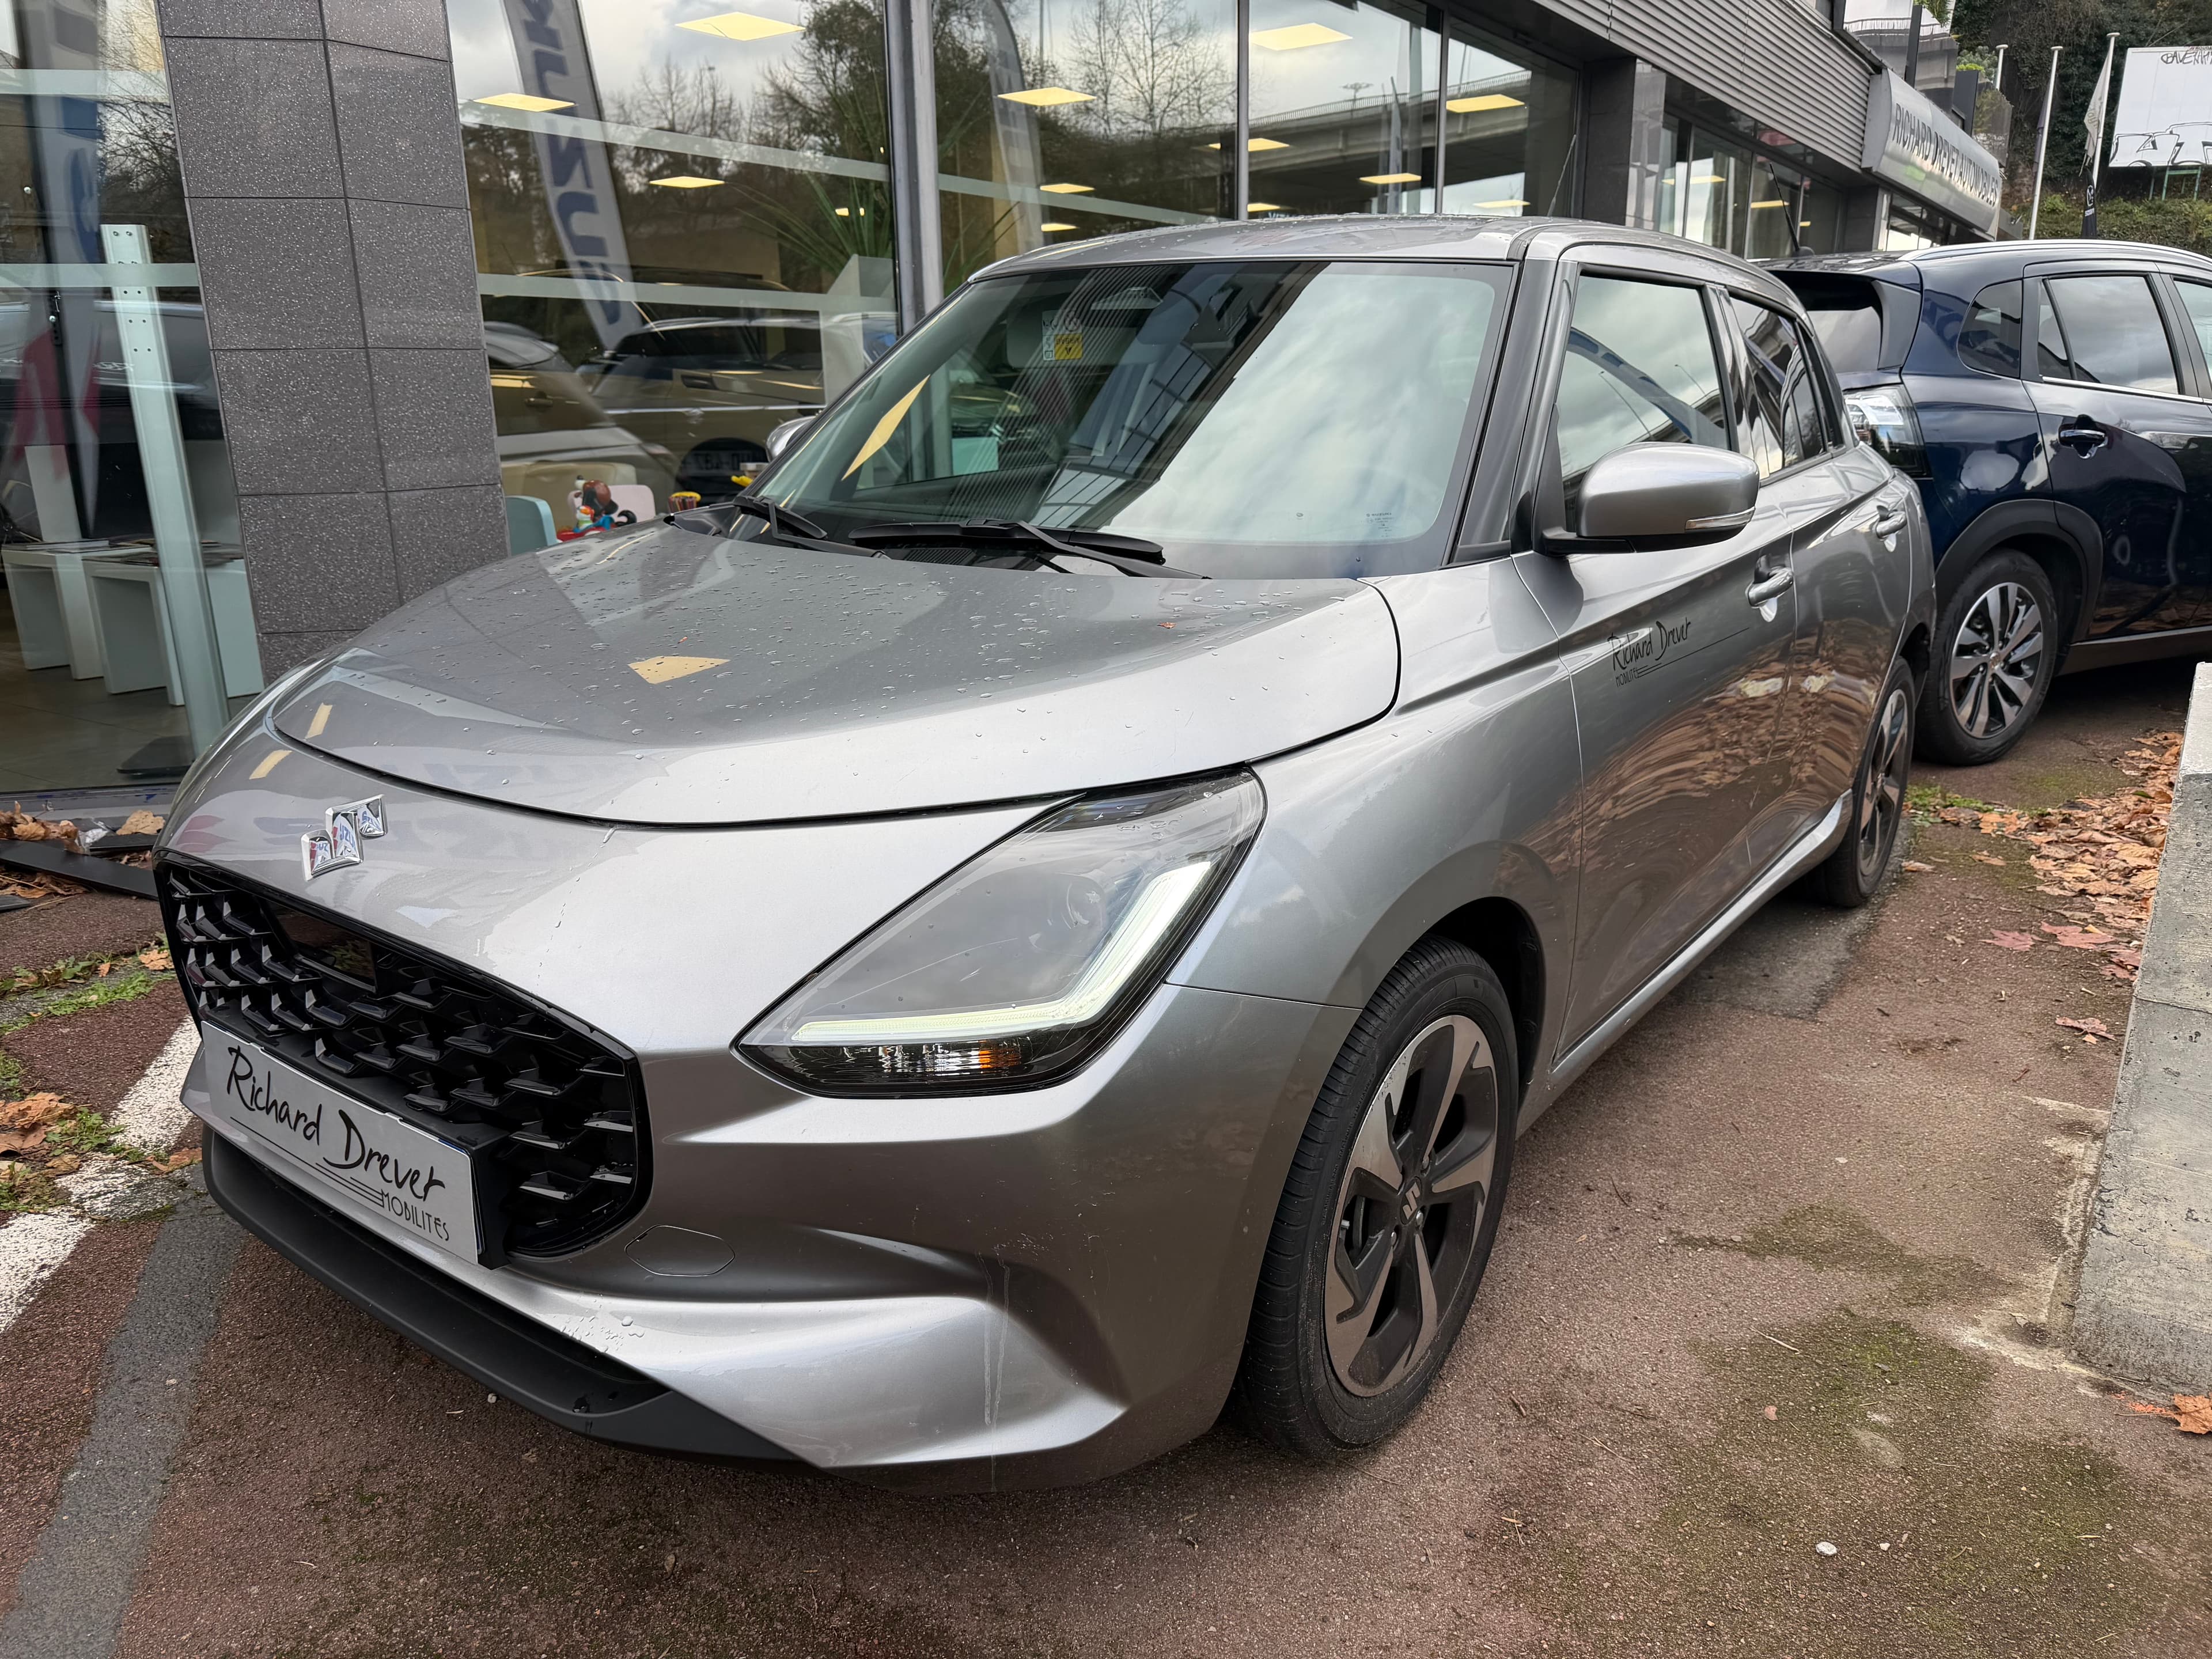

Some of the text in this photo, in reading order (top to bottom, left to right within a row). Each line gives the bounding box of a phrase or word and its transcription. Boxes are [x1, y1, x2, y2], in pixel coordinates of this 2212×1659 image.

[1892, 103, 1999, 208] RICHARD DREVET AUTOMOBILES
[1607, 617, 1691, 671] Richard Drevet
[227, 1045, 445, 1202] Richard Drevet
